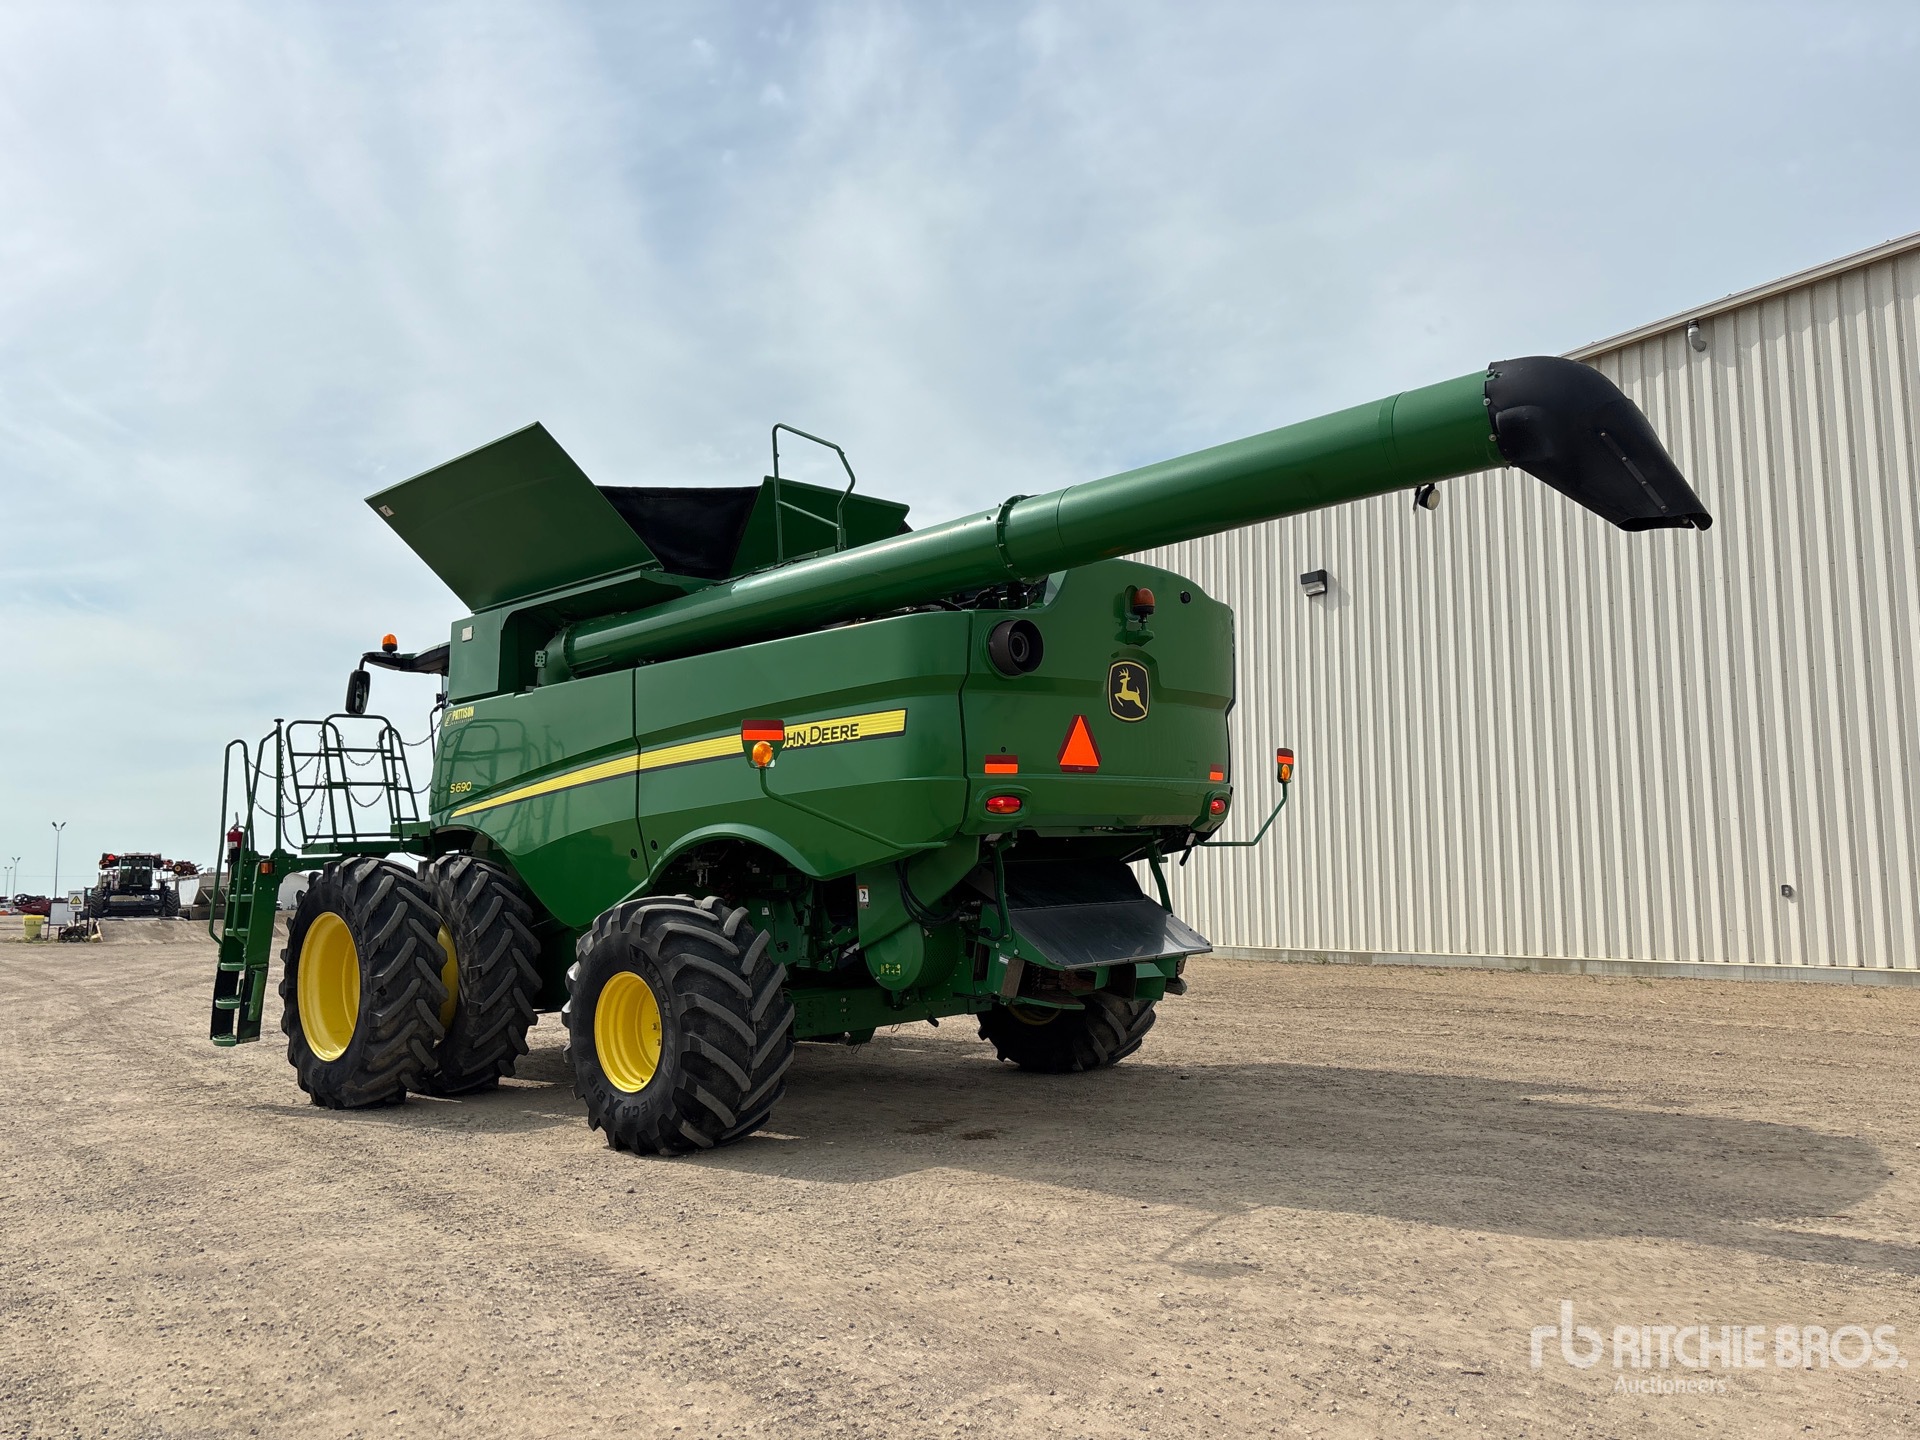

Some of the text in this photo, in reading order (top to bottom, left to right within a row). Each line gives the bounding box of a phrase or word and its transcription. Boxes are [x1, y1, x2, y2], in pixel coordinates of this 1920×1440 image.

[452, 705, 475, 721] PATTISON
[784, 723, 859, 747] HN DEERE
[450, 781, 472, 794] S690
